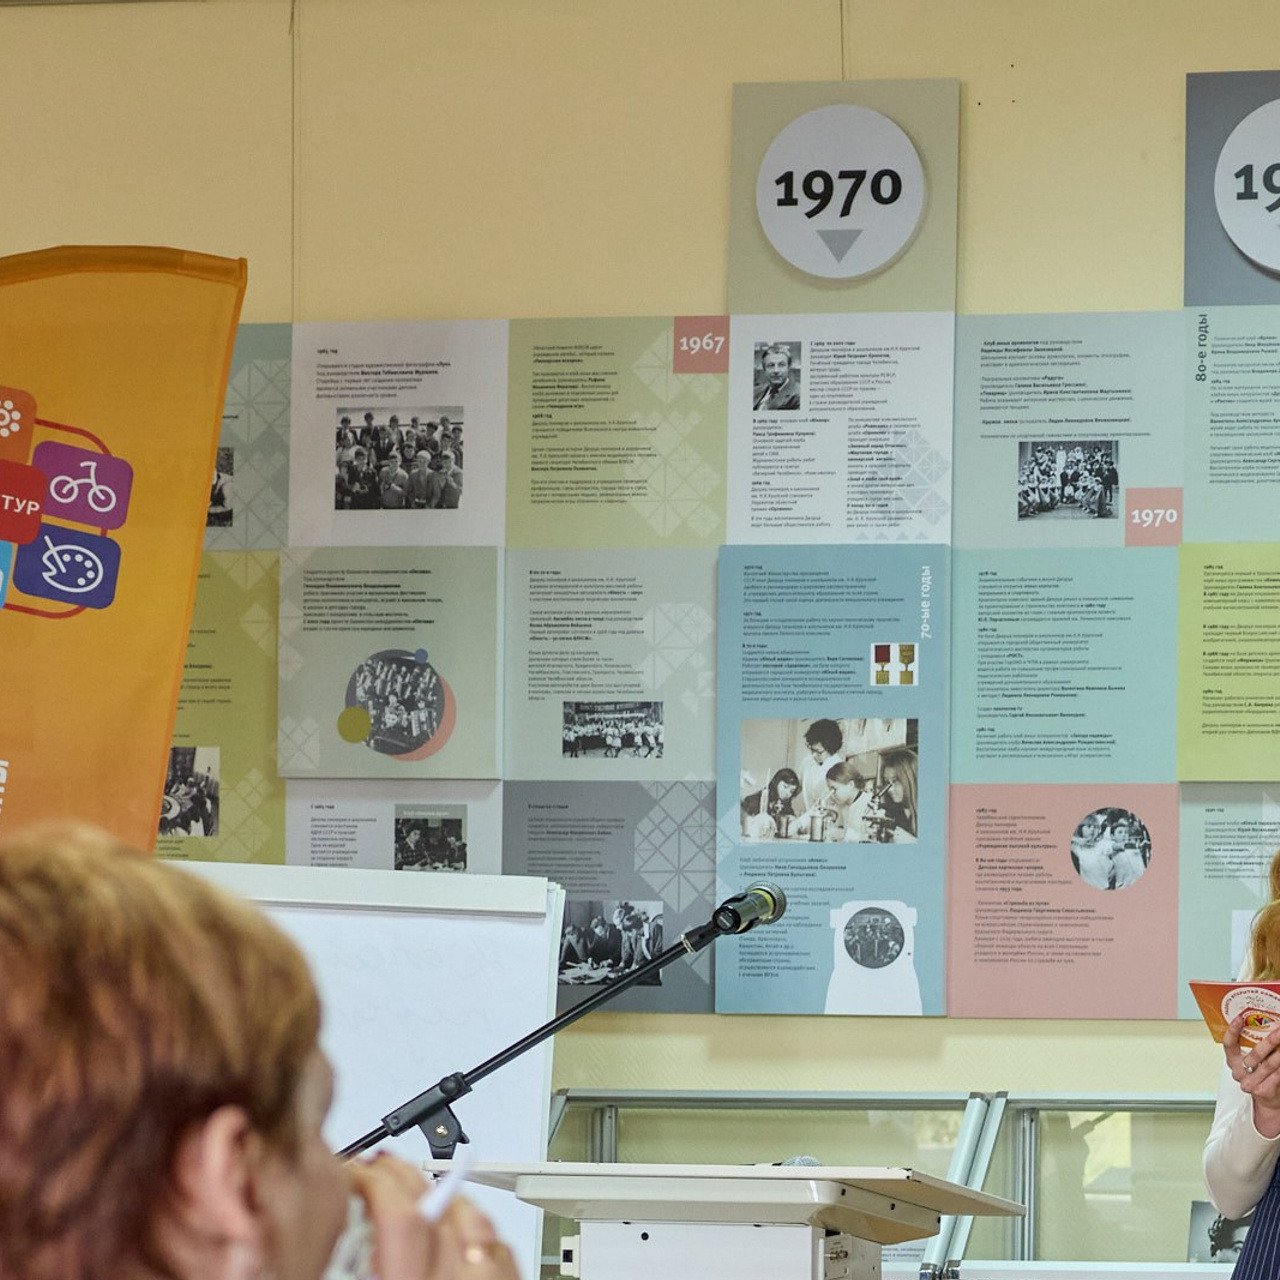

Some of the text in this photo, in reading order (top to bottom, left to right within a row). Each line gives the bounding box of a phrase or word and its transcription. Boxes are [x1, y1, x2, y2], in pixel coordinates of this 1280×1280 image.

[775, 168, 902, 220] 1970
[679, 332, 725, 355] 1967
[1198, 313, 1209, 348] годы
[1, 494, 40, 515] ТУР
[1131, 508, 1178, 528] 1970
[921, 565, 933, 598] годы
